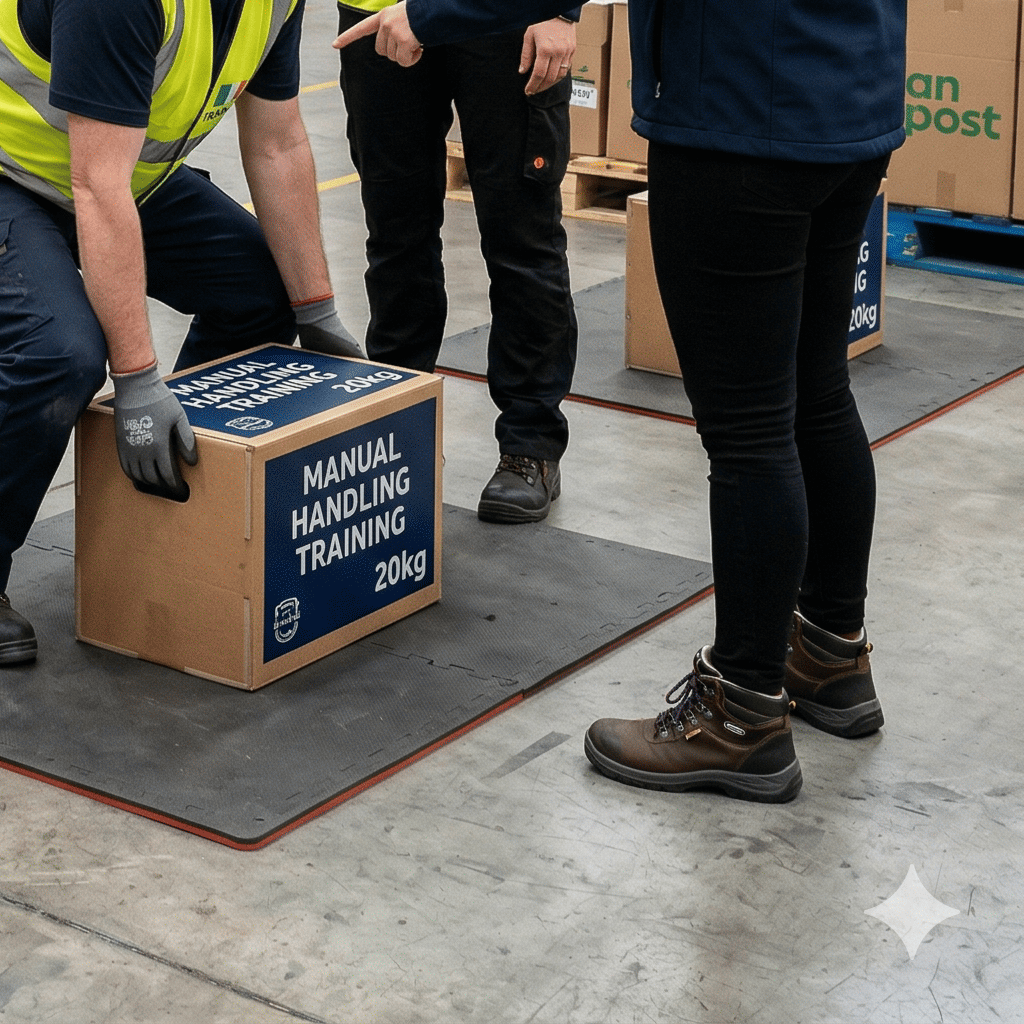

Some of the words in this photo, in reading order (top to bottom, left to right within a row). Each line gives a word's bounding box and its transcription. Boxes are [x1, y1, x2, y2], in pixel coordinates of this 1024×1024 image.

[906, 73, 960, 103] an
[905, 103, 1001, 140] post
[849, 303, 877, 332] 20kg
[170, 361, 276, 396] MANUAL
[181, 362, 315, 409] HANDLING
[216, 371, 337, 411] TRAINING
[332, 371, 403, 393] 20kg
[303, 432, 401, 495] MANUAL
[292, 466, 410, 540] HANDLING
[295, 505, 405, 576] TRAINING
[375, 549, 426, 592] 20kg
